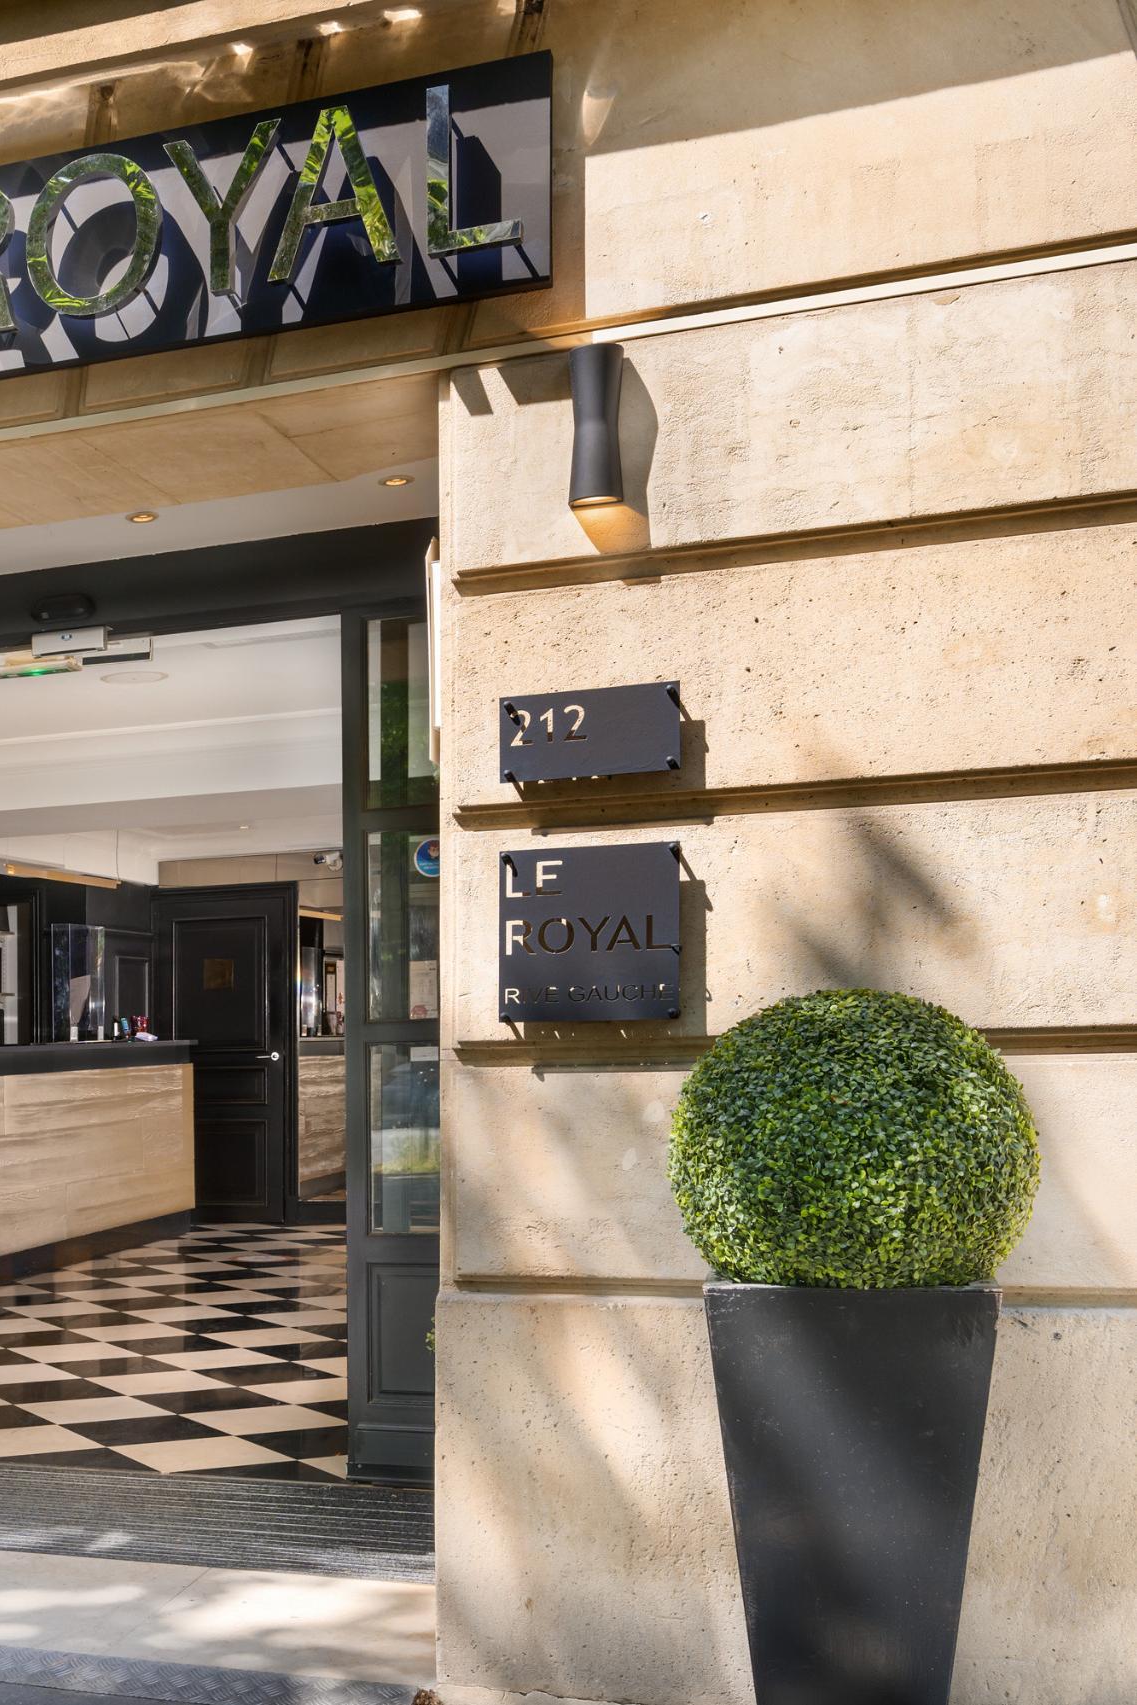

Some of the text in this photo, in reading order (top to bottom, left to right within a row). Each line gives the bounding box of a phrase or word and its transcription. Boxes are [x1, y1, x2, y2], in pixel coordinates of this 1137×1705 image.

[509, 704, 588, 747] 212
[505, 860, 564, 898] LE
[505, 914, 675, 956] ROYAL
[568, 984, 674, 1002] GAUCHE
